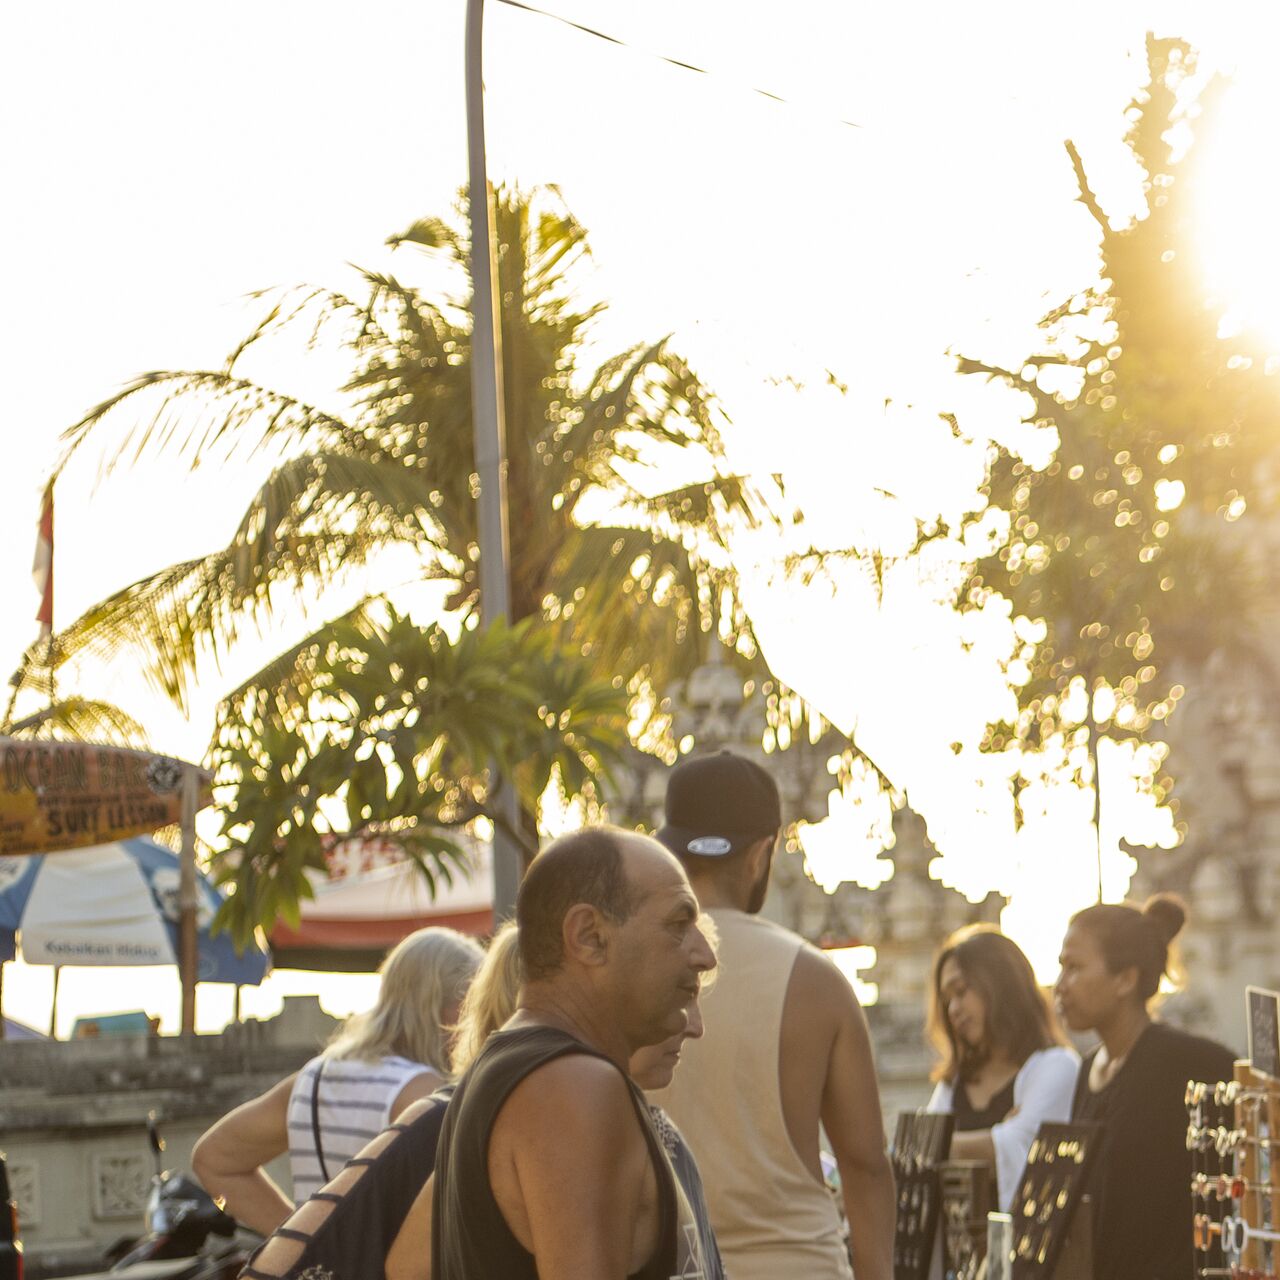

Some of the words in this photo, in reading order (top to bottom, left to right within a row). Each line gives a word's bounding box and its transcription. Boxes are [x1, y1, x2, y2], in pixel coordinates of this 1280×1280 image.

[5, 746, 87, 793] OCEAN
[97, 751, 145, 788] BAR
[47, 808, 99, 836] SURF
